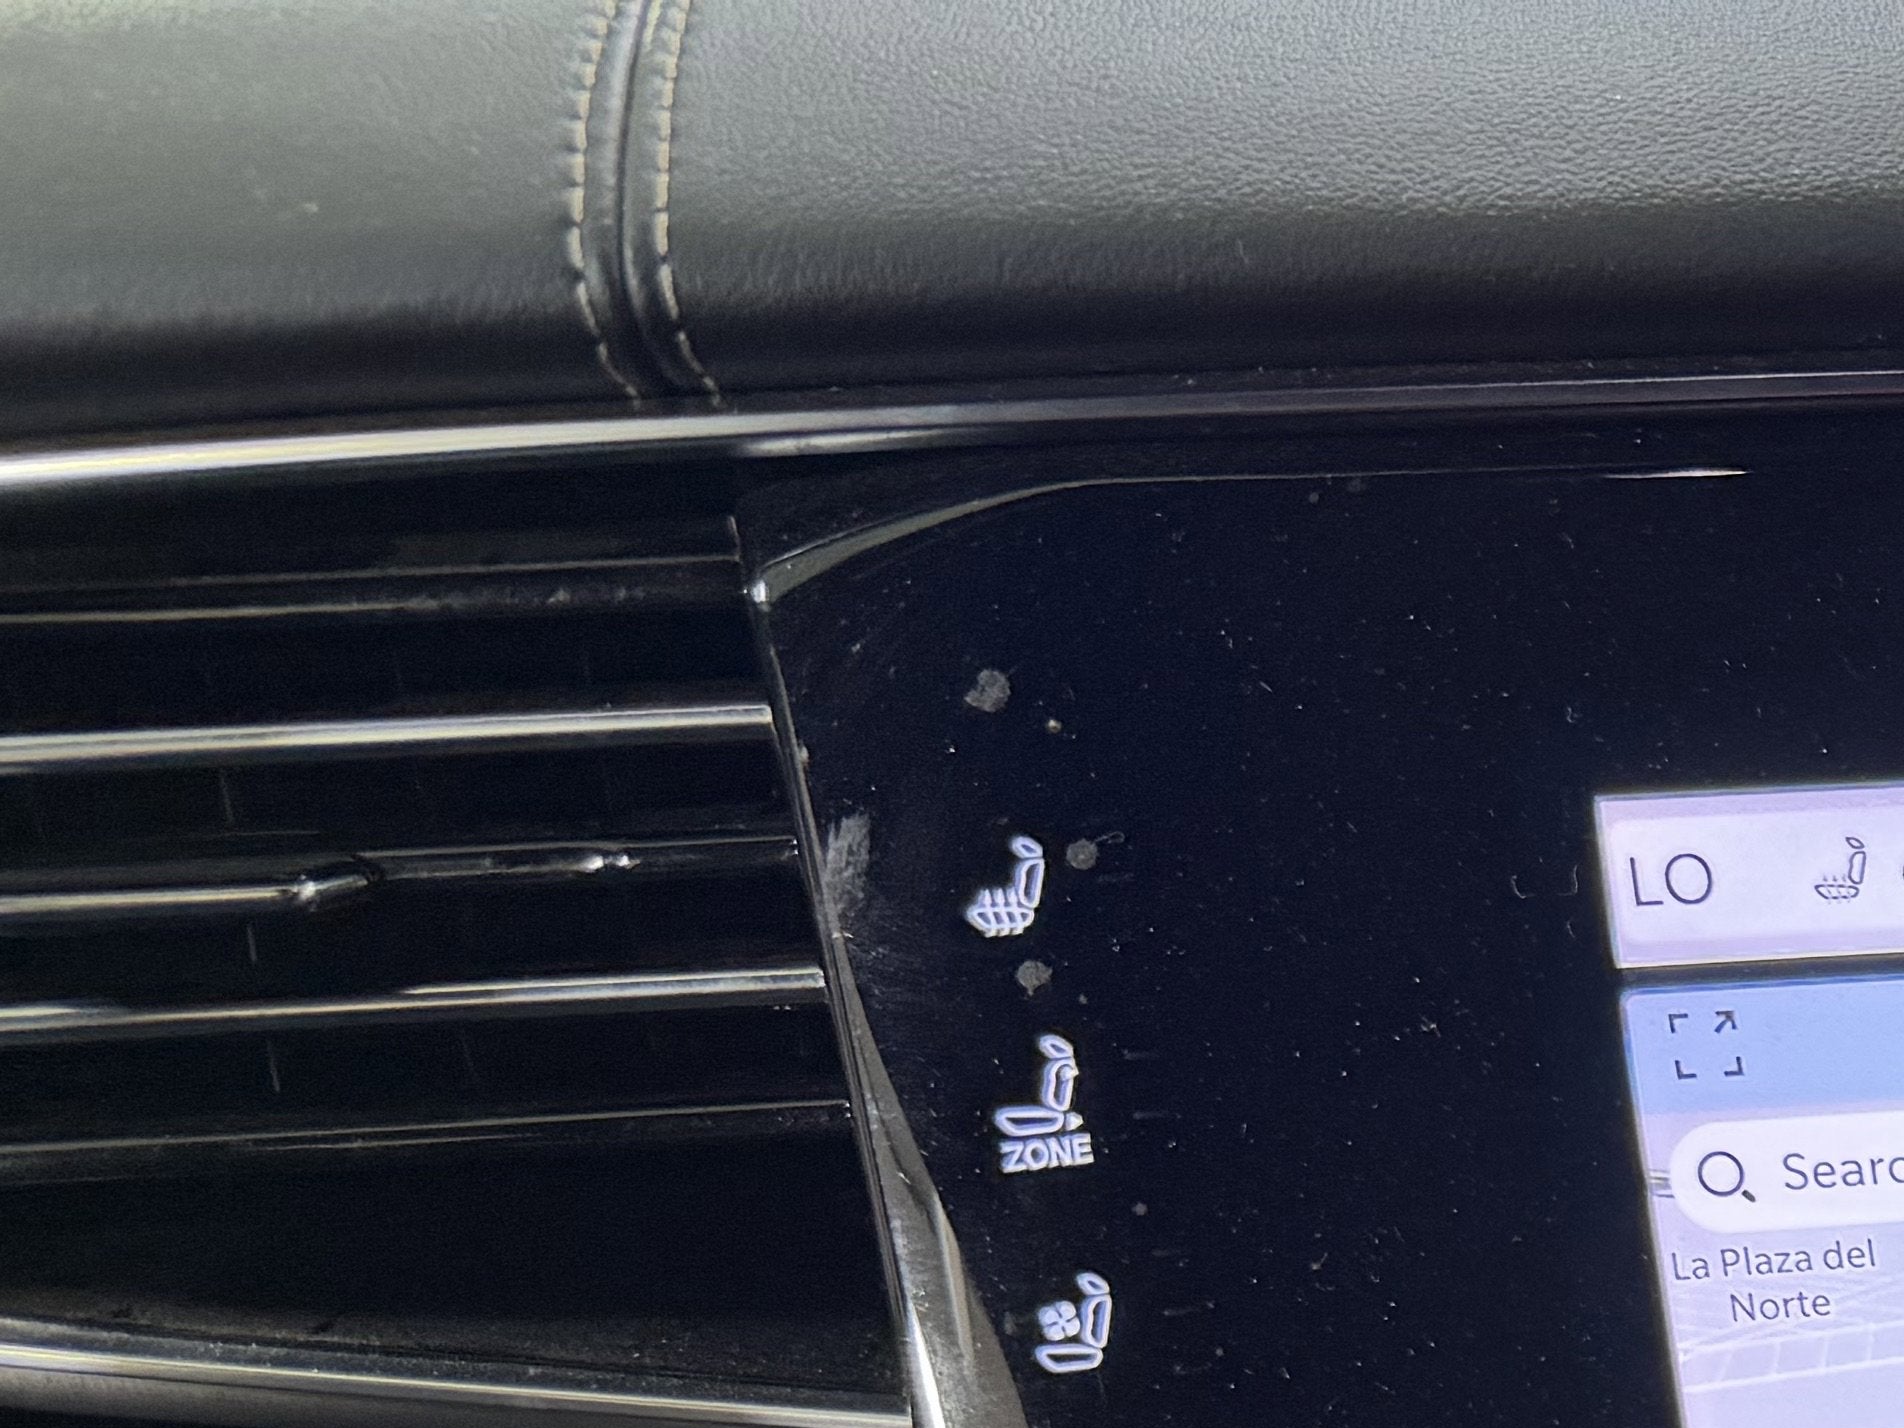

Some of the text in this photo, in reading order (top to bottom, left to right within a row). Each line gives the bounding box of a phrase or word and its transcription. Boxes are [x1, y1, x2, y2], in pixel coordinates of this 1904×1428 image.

[1629, 853, 1713, 907] LO
[999, 1133, 1095, 1173] ZONE
[1671, 1238, 1876, 1281] La Plaza del
[1729, 1291, 1831, 1323] Norte
